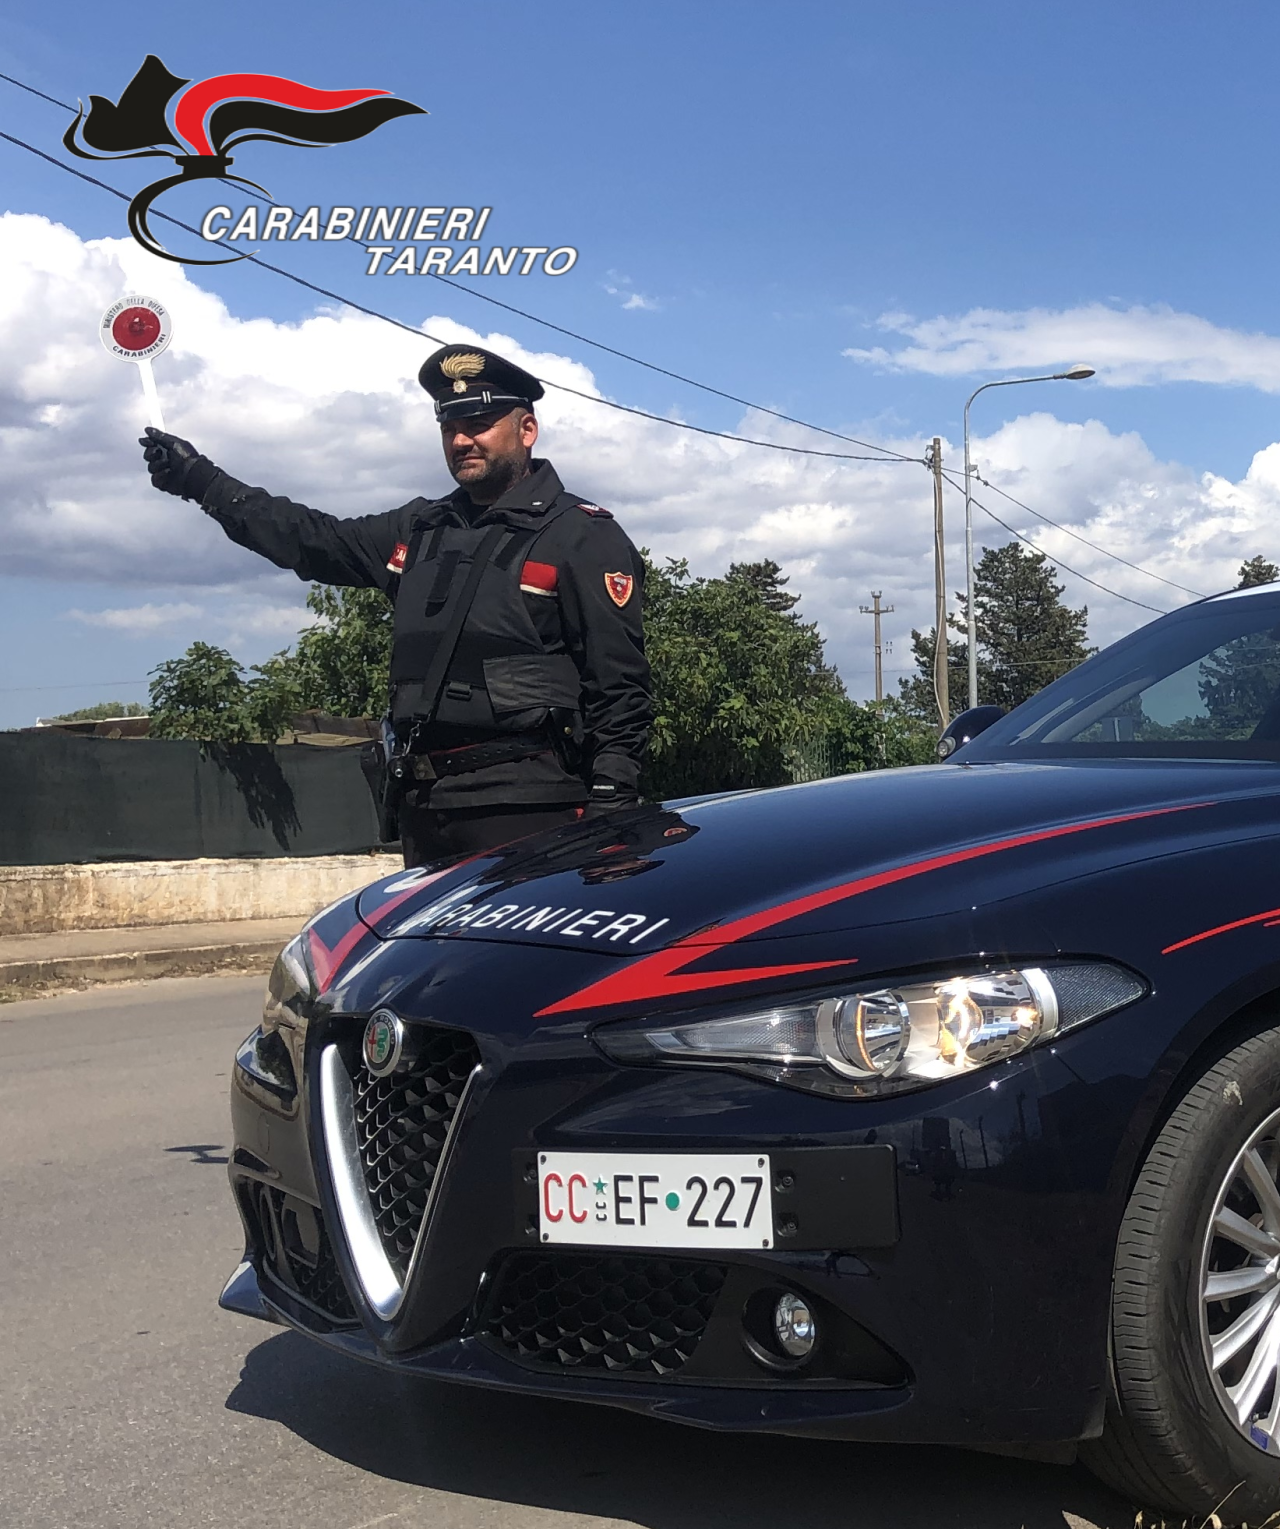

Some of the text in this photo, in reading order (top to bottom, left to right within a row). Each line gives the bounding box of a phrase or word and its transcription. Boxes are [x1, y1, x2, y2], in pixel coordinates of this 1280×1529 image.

[112, 333, 167, 357] CARABINIERI
[543, 1173, 588, 1223] CC
[613, 1174, 660, 1226] EF
[685, 1175, 764, 1228] 227
